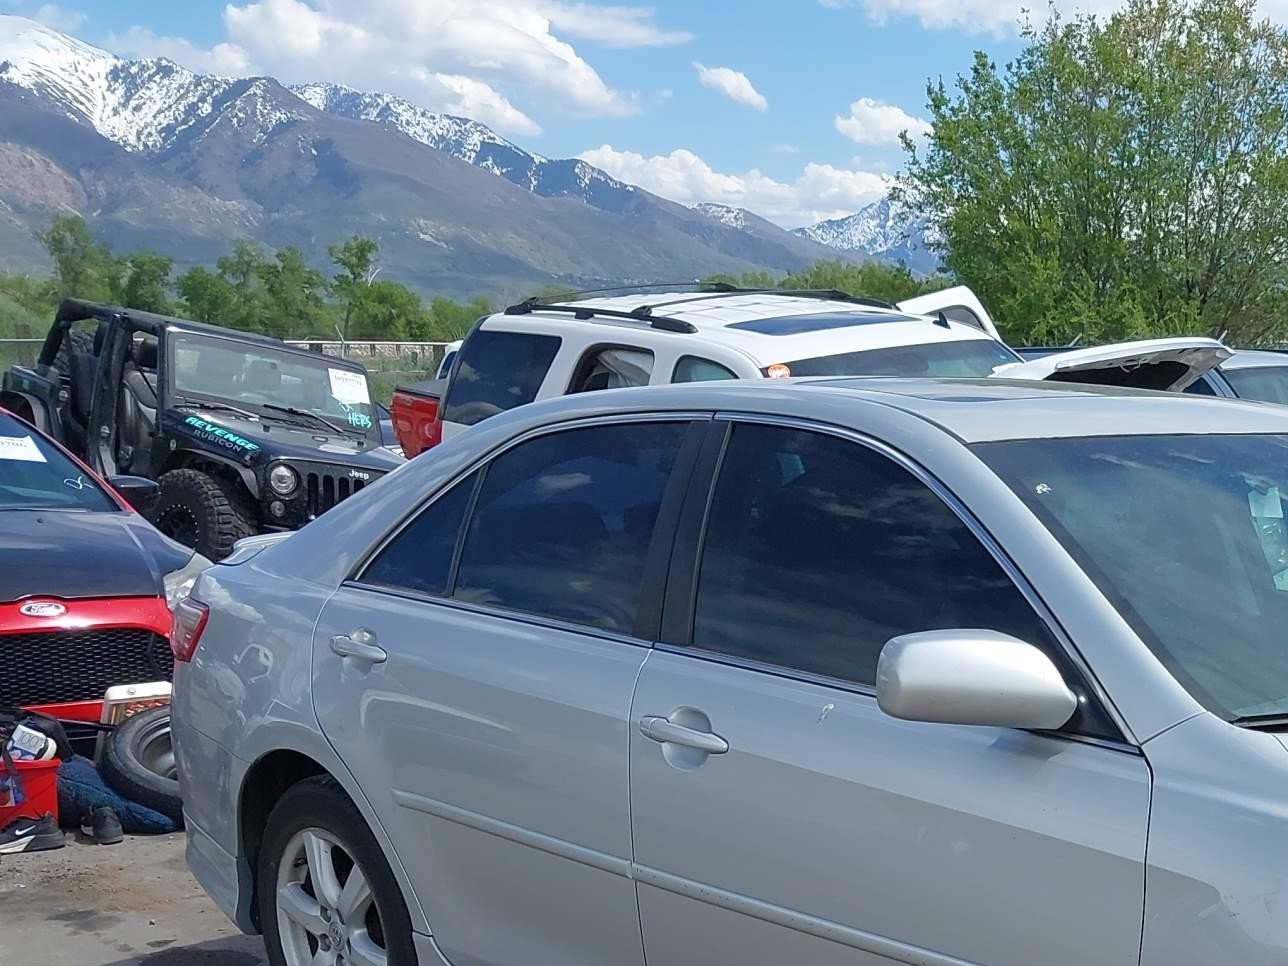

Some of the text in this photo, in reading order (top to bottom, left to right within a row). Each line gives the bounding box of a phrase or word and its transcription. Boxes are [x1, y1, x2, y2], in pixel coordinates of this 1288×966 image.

[185, 416, 260, 451] REVENGE
[193, 429, 243, 453] RUBICON
[348, 469, 370, 480] Jeep
